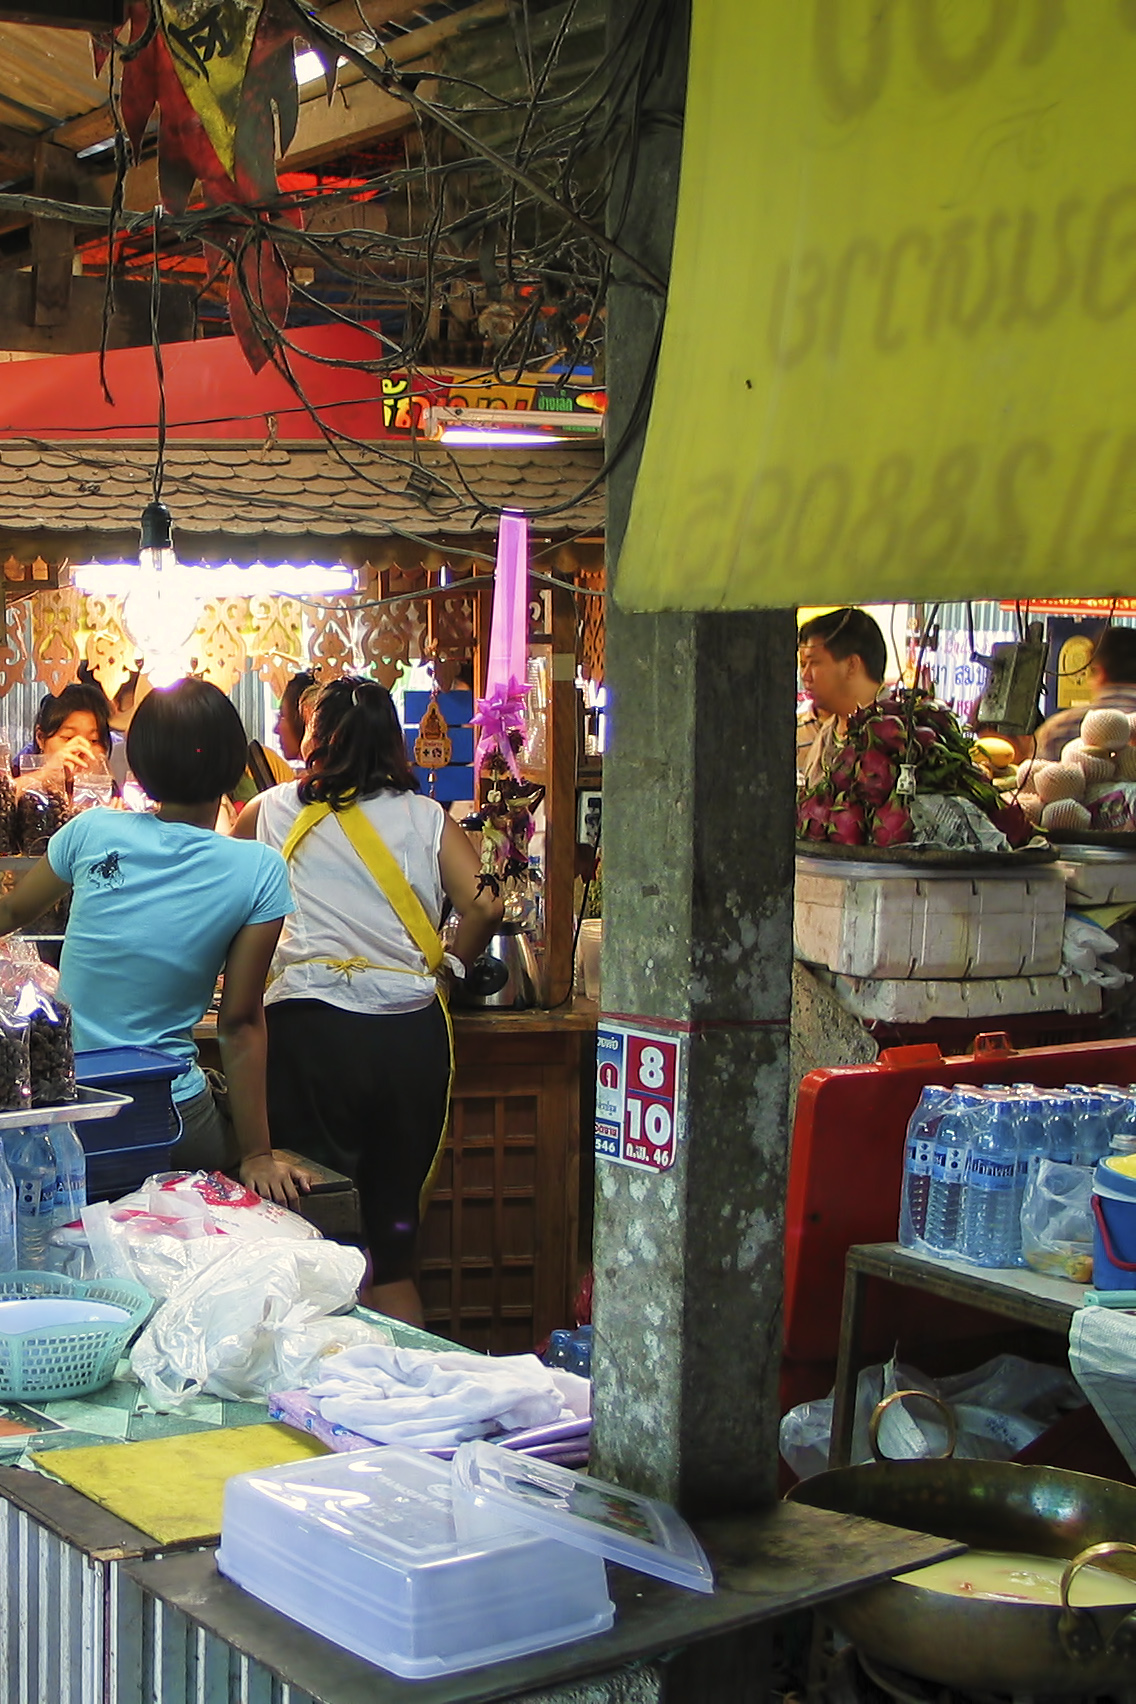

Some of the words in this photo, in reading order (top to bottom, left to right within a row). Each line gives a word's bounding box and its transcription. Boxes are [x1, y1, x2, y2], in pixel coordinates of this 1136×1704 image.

[639, 1046, 665, 1089] 8
[627, 1098, 671, 1146] 10
[653, 1148, 669, 1167] 46
